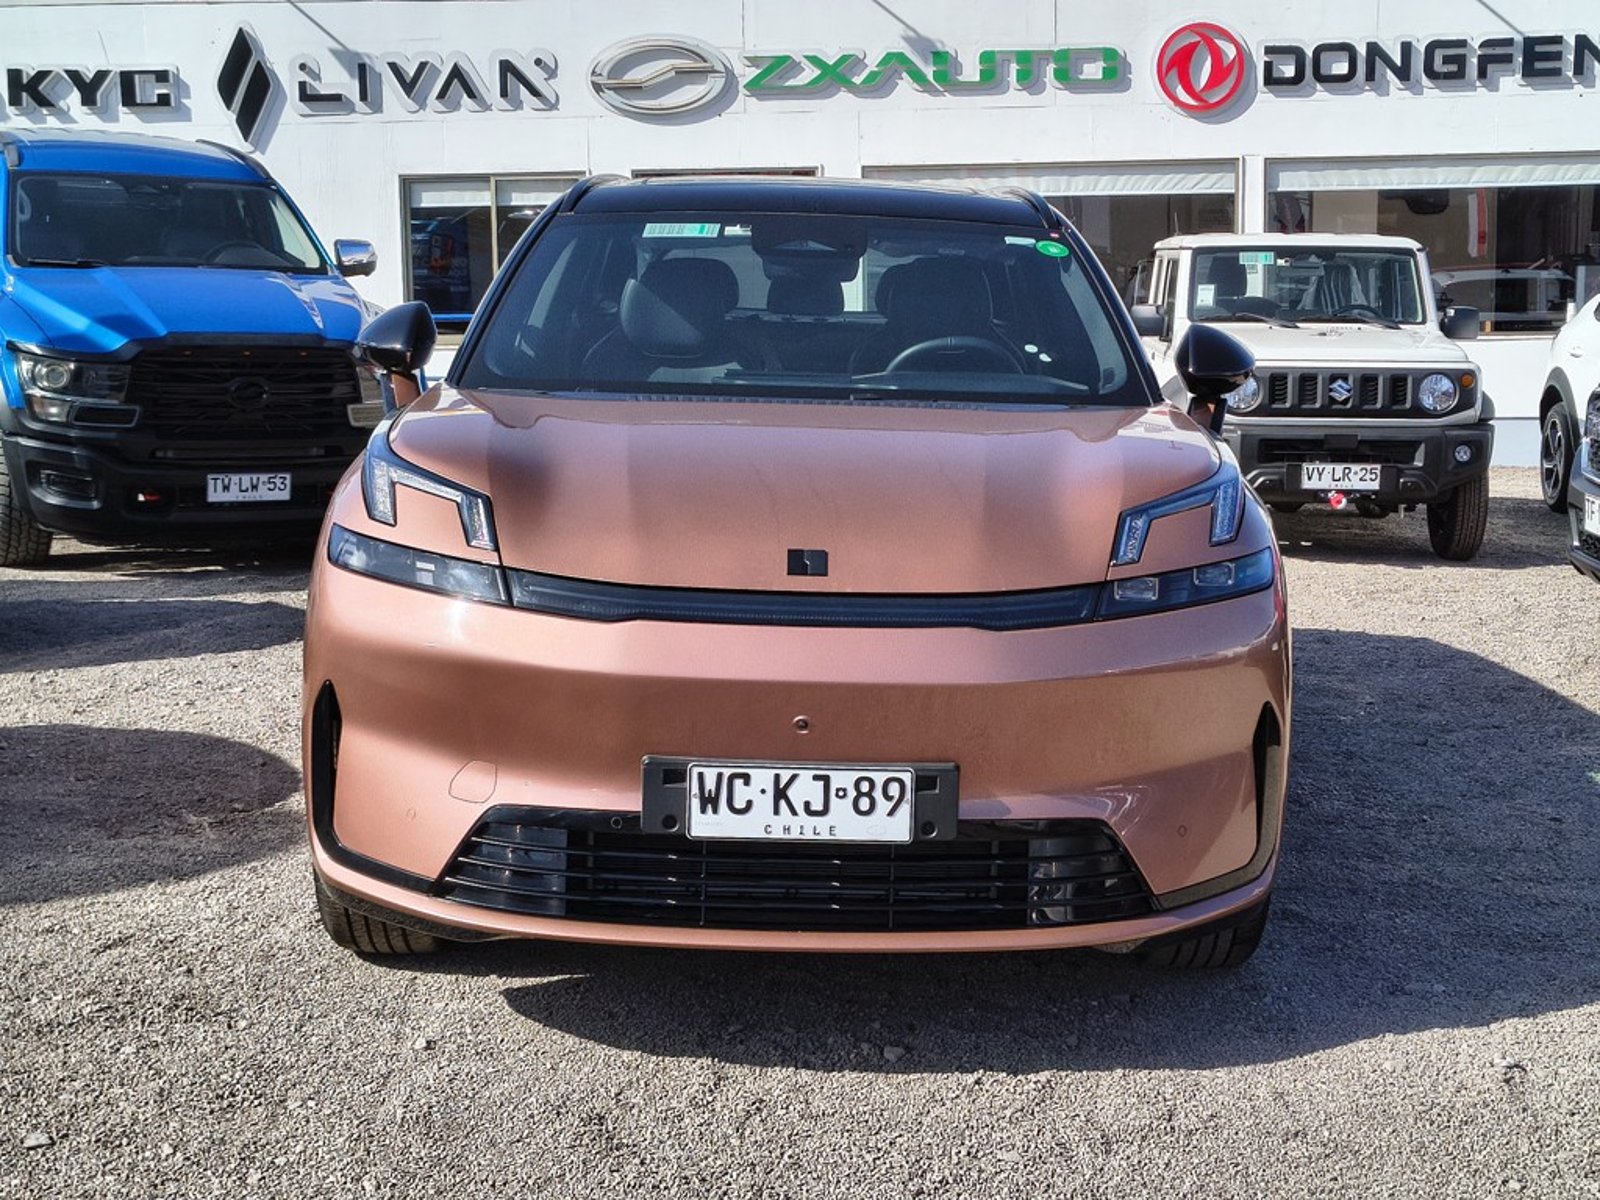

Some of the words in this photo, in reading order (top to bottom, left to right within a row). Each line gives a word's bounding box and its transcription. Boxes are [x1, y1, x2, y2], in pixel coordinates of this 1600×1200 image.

[7, 68, 172, 108] KYC
[299, 57, 551, 103] LIVAN
[742, 46, 1120, 92] ZXAUTO
[763, 824, 837, 837] CHILE
